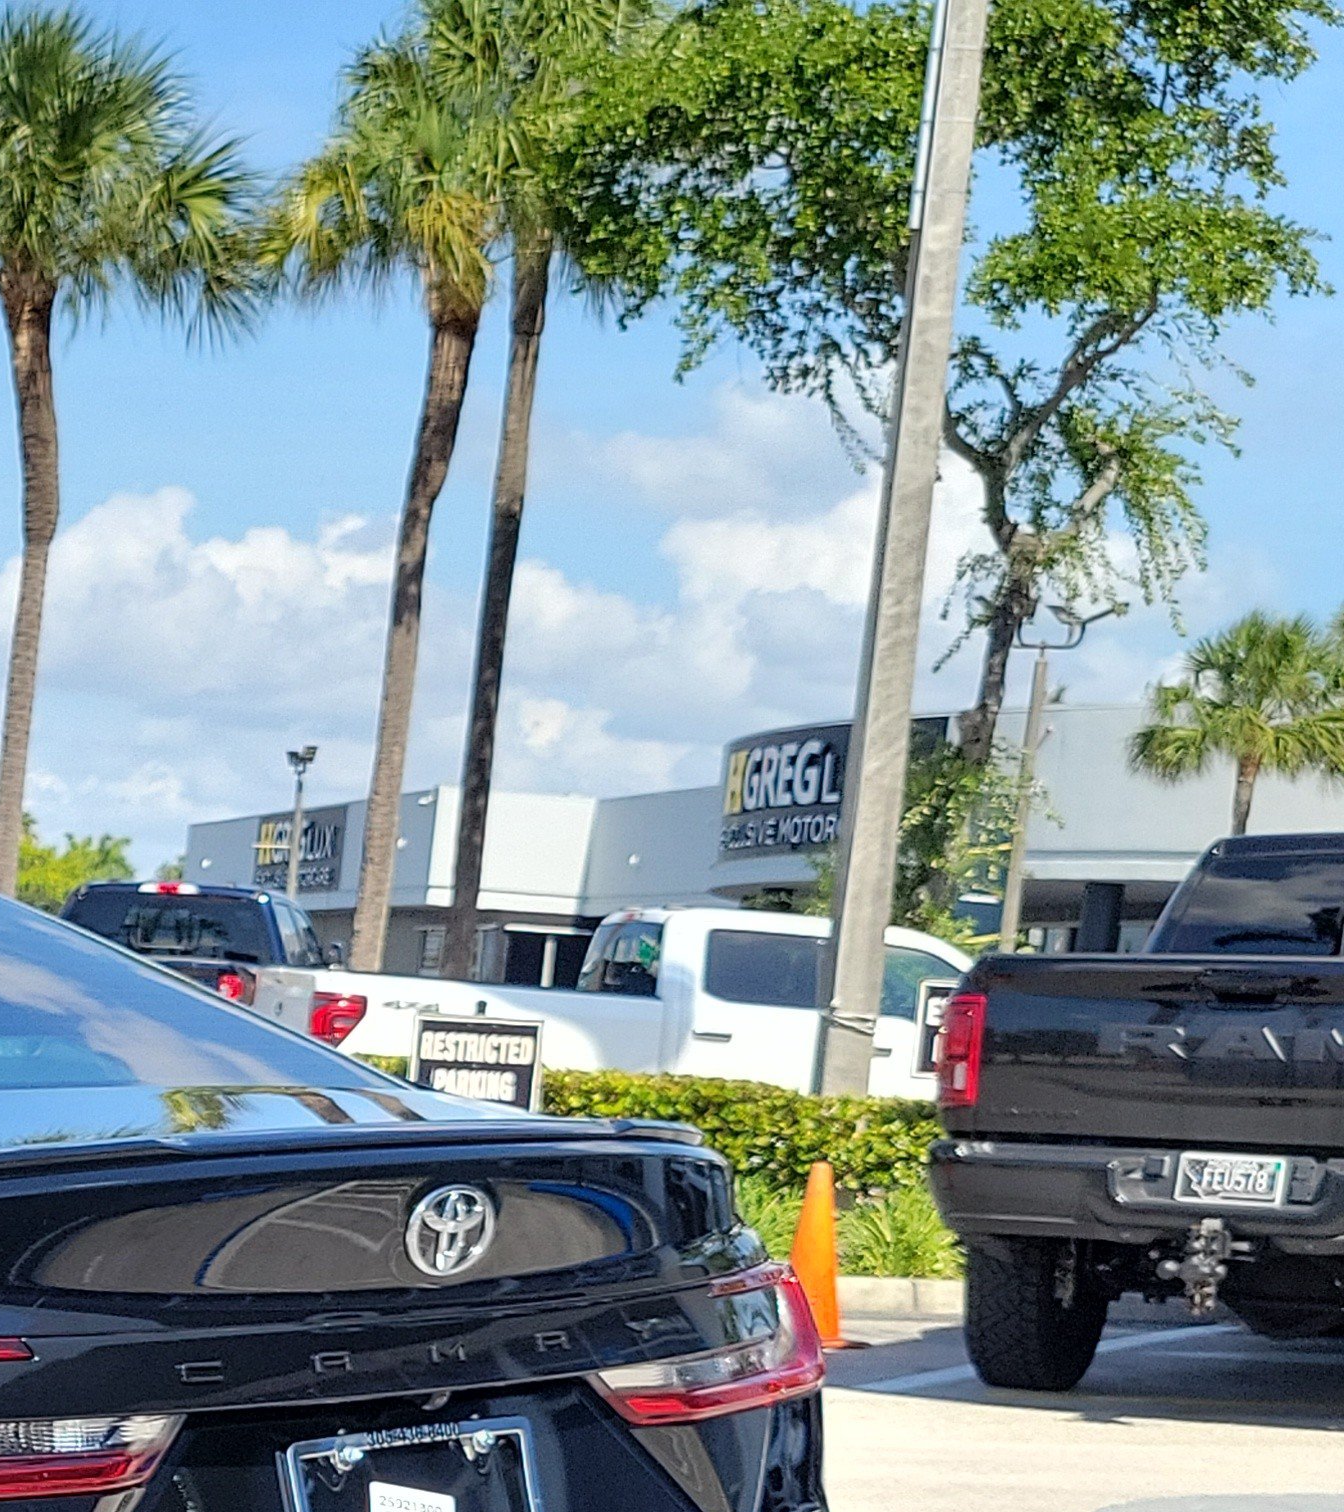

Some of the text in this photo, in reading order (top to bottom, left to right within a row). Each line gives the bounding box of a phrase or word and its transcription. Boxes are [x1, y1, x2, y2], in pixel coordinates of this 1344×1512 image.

[419, 1030, 536, 1065] RESTRICTED
[431, 1067, 517, 1102] PARKING
[176, 1314, 694, 1384] CAMRY
